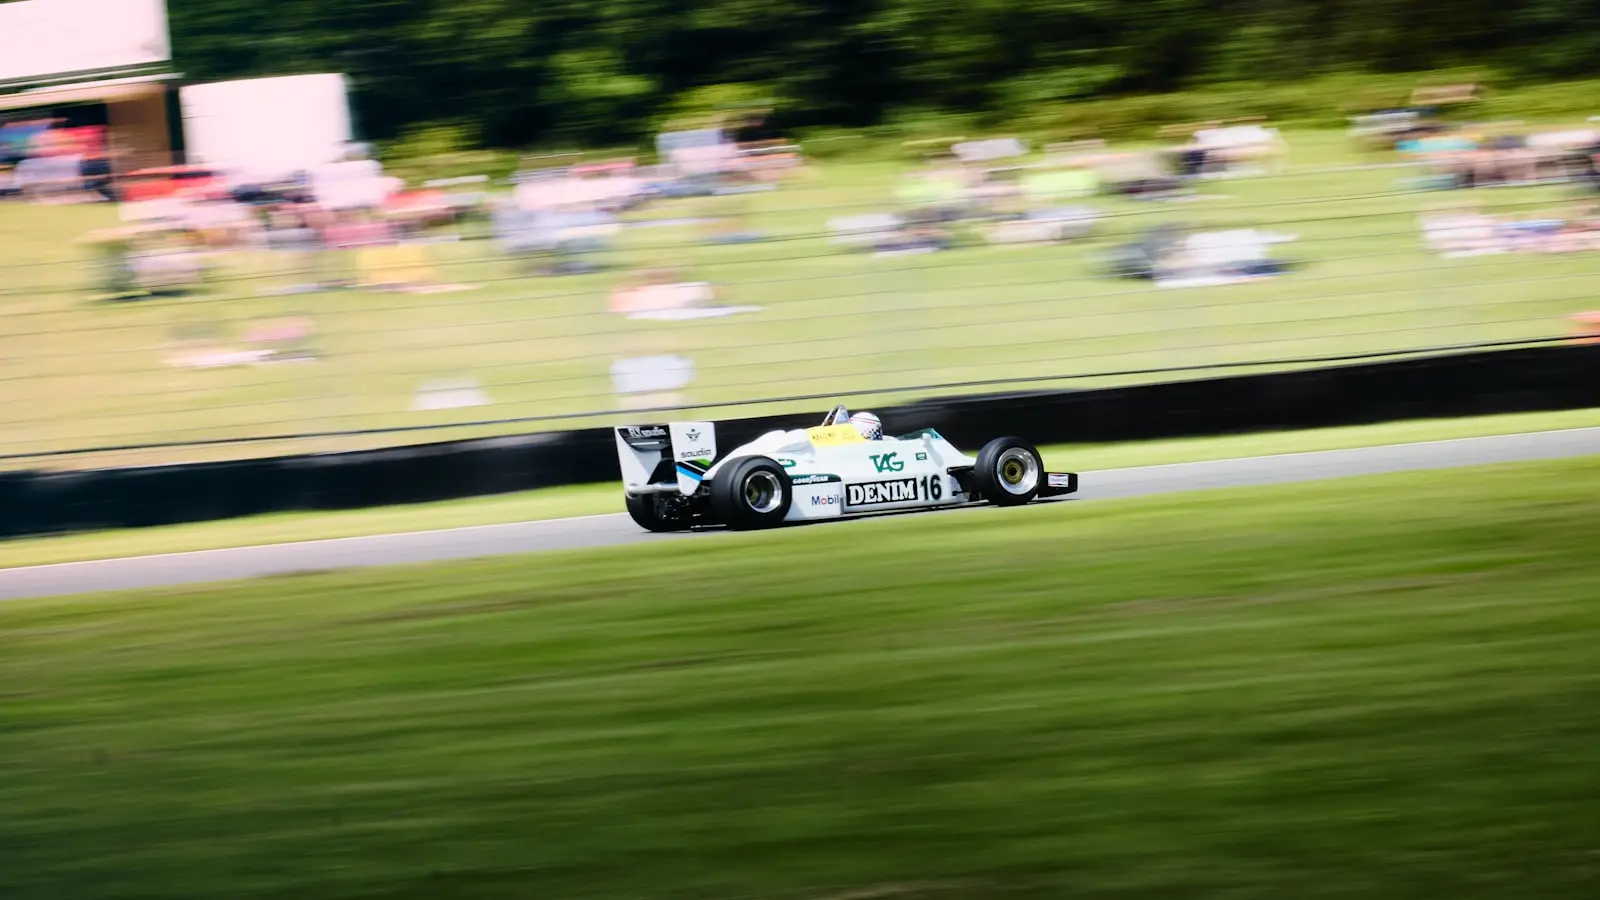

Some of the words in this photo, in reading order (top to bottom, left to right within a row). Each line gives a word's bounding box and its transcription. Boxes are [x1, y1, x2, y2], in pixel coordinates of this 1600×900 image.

[680, 448, 712, 458] saudia
[869, 451, 904, 473] TAG
[849, 480, 915, 504] DENIM
[920, 474, 942, 500] 16
[811, 494, 840, 506] Mobil
